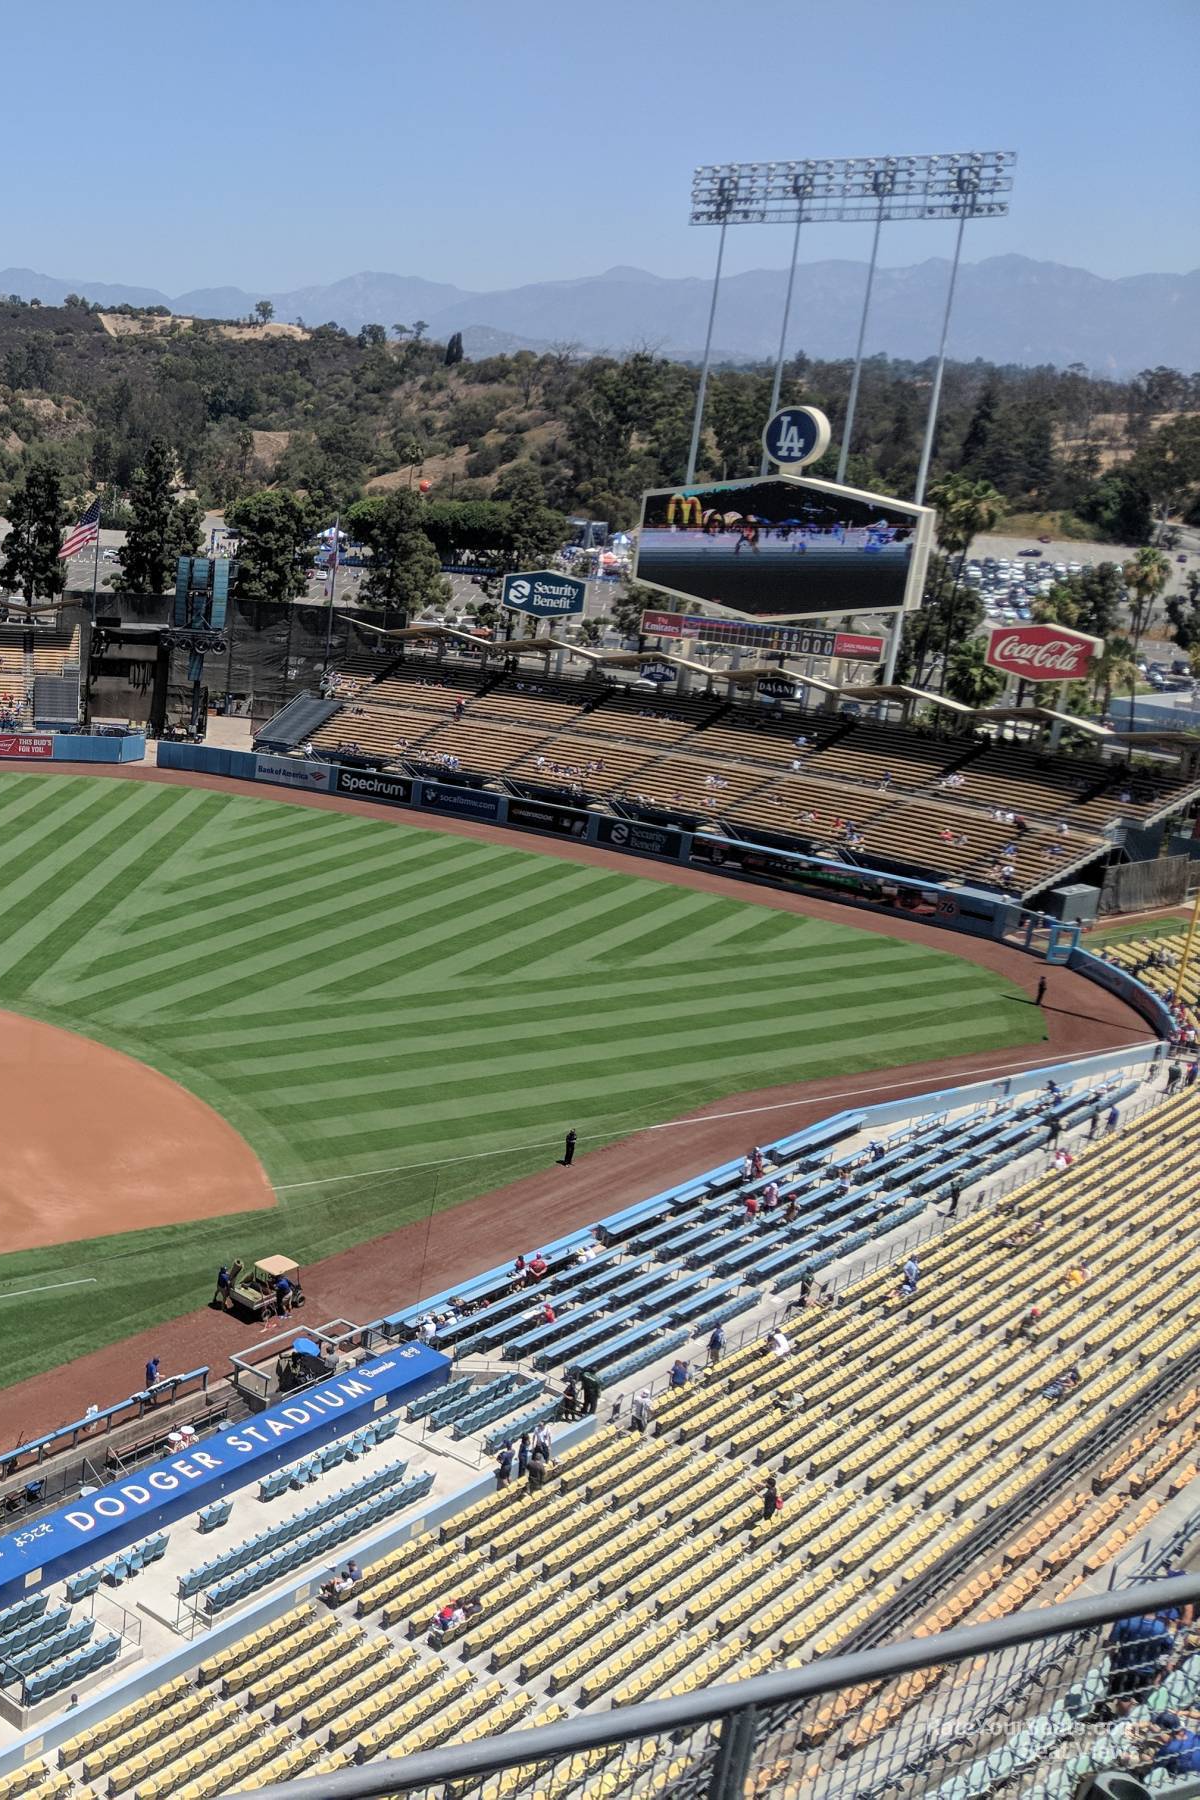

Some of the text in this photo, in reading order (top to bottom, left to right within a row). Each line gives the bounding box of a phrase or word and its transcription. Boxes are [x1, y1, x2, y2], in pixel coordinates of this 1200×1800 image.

[776, 416, 805, 457] LA
[534, 582, 579, 600] Security
[533, 595, 570, 609] Benefit
[645, 622, 680, 633] Emirates
[801, 638, 832, 655] 0 0 0
[656, 664, 675, 678] BEAM
[759, 682, 794, 694] DASANI
[258, 766, 274, 775] Bank
[282, 769, 308, 780] America
[341, 773, 403, 796] Spectrum
[630, 836, 662, 852] Benefit
[632, 826, 668, 846] Security
[940, 902, 954, 913] 76
[64, 1378, 373, 1532] DODGER STADIUM
